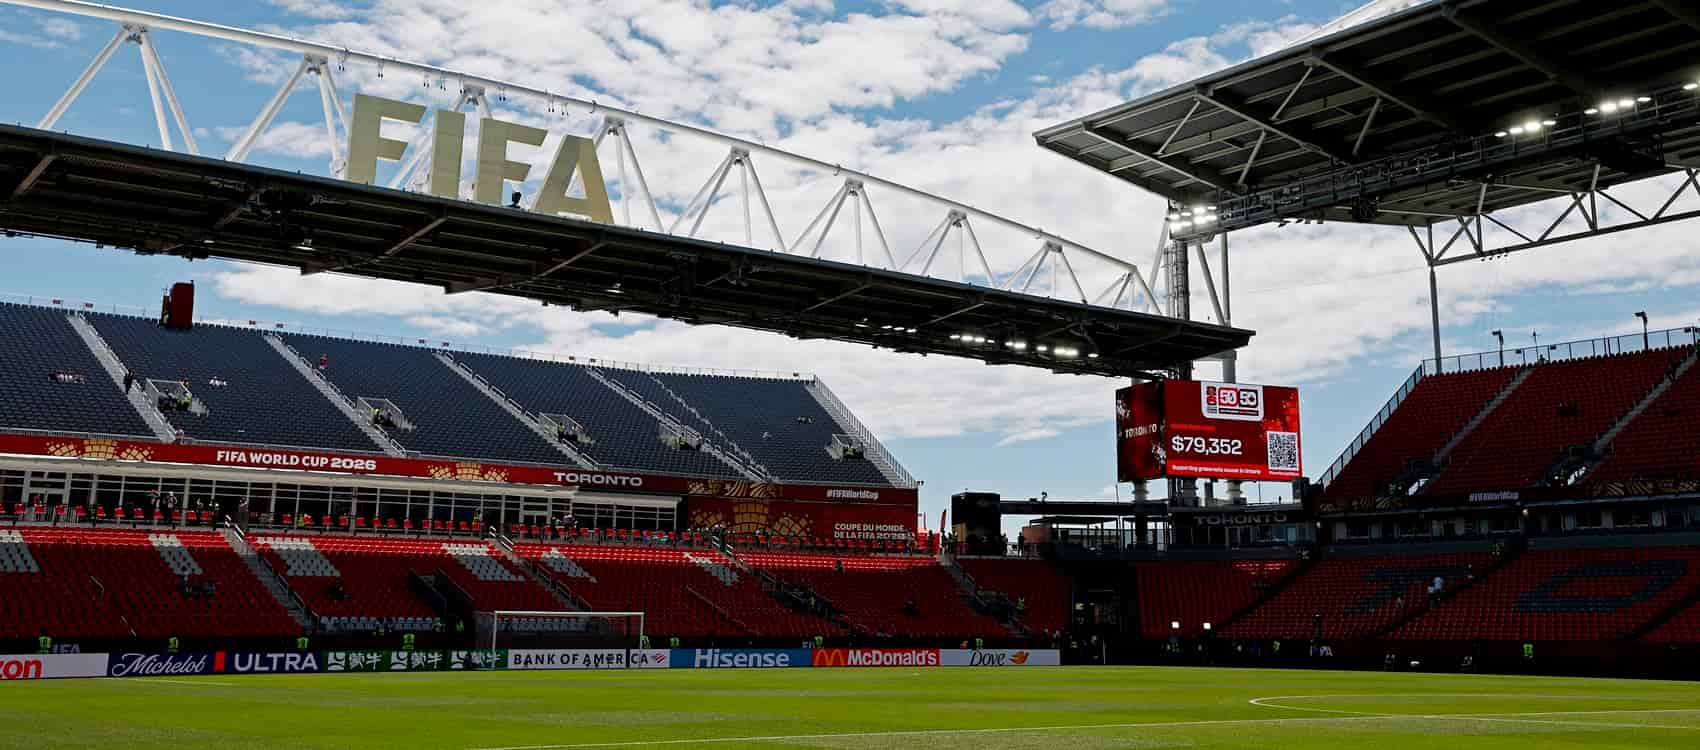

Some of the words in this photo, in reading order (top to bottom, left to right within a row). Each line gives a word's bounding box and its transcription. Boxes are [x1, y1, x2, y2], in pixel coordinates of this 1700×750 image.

[345, 93, 614, 225] FIFA
[1219, 389, 1238, 405] 50
[1240, 391, 1256, 406] 50
[1171, 435, 1243, 456] $79,352
[216, 450, 247, 464] FIFA
[249, 453, 300, 466] WORLD
[302, 456, 329, 468] CUP
[330, 458, 377, 471] 2026
[554, 472, 643, 487] TORONTO
[834, 523, 861, 532] COUPE
[863, 523, 874, 532] DU
[875, 523, 905, 533] MONDE
[1193, 513, 1288, 526] TORONTO
[834, 531, 845, 540] DE
[847, 531, 856, 540] LA
[858, 531, 876, 540] FIFA
[111, 652, 208, 677] Michelob
[234, 653, 319, 672] ULTRA
[513, 653, 555, 666] BANK
[560, 653, 579, 666] OF
[582, 652, 649, 666] AMERCA
[694, 649, 790, 668] Hisense
[847, 649, 937, 667] McDonald's
[969, 650, 1007, 667] Dove
[0, 659, 43, 680] on
